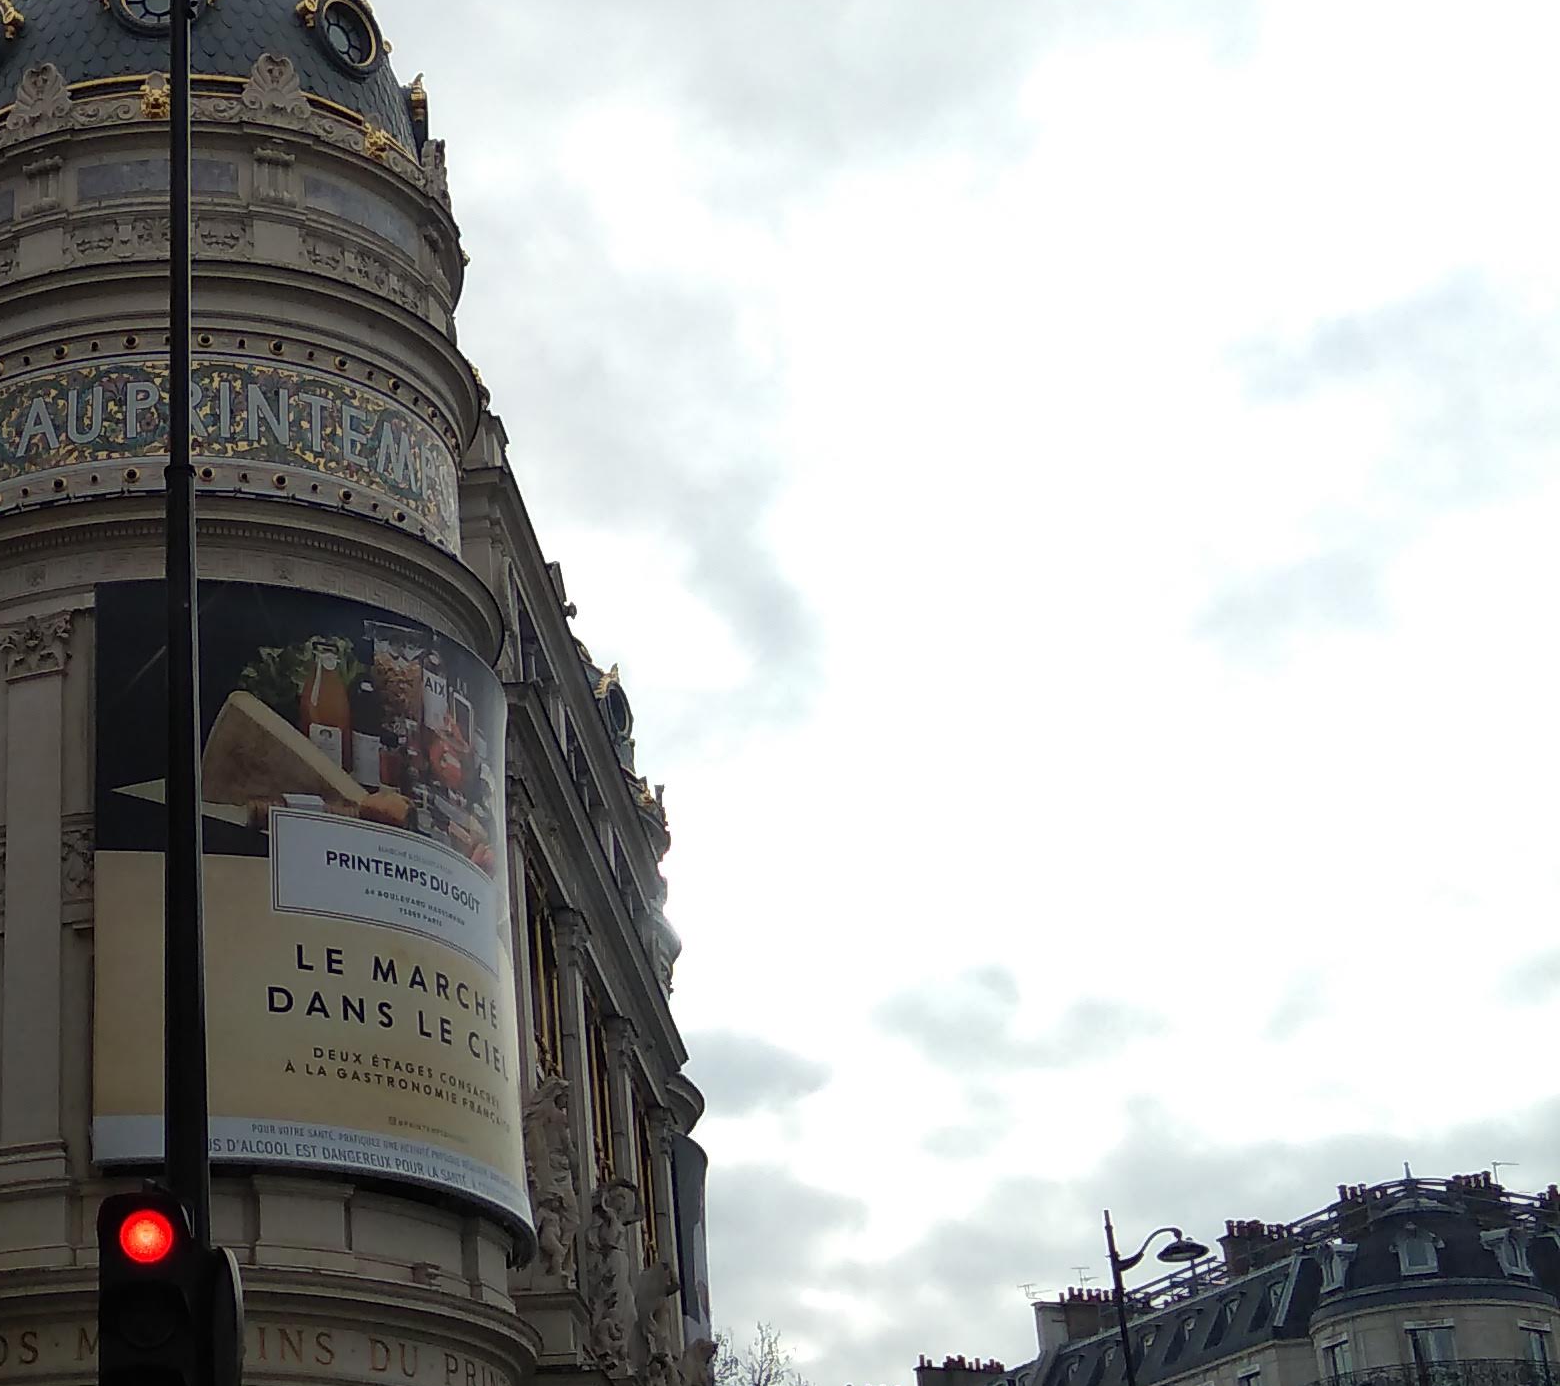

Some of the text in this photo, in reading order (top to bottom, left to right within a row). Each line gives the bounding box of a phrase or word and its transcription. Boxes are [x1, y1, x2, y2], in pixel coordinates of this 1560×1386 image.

[15, 385, 104, 458] AU
[326, 849, 427, 888] PRINTEMPS
[430, 875, 449, 896] DU
[451, 885, 481, 915] GOÛT
[296, 943, 498, 1030] LE MARCHÉ
[267, 985, 509, 1082] DANS LE CIEL
[284, 1059, 296, 1074] À
[305, 1063, 327, 1077] LA
[336, 1067, 458, 1105] GASTRONOMIE
[313, 1047, 362, 1065] DEUX
[371, 1054, 433, 1079] ÉTAGES
[251, 1123, 275, 1134] POUR
[278, 1125, 304, 1138] VOTRE
[227, 1138, 291, 1156] D'ALCOOL
[296, 1143, 318, 1158] EST
[322, 1147, 392, 1171] DANGEREUX
[395, 1158, 425, 1176] POUR
[427, 1165, 439, 1179] LA
[368, 1333, 420, 1378] DU
